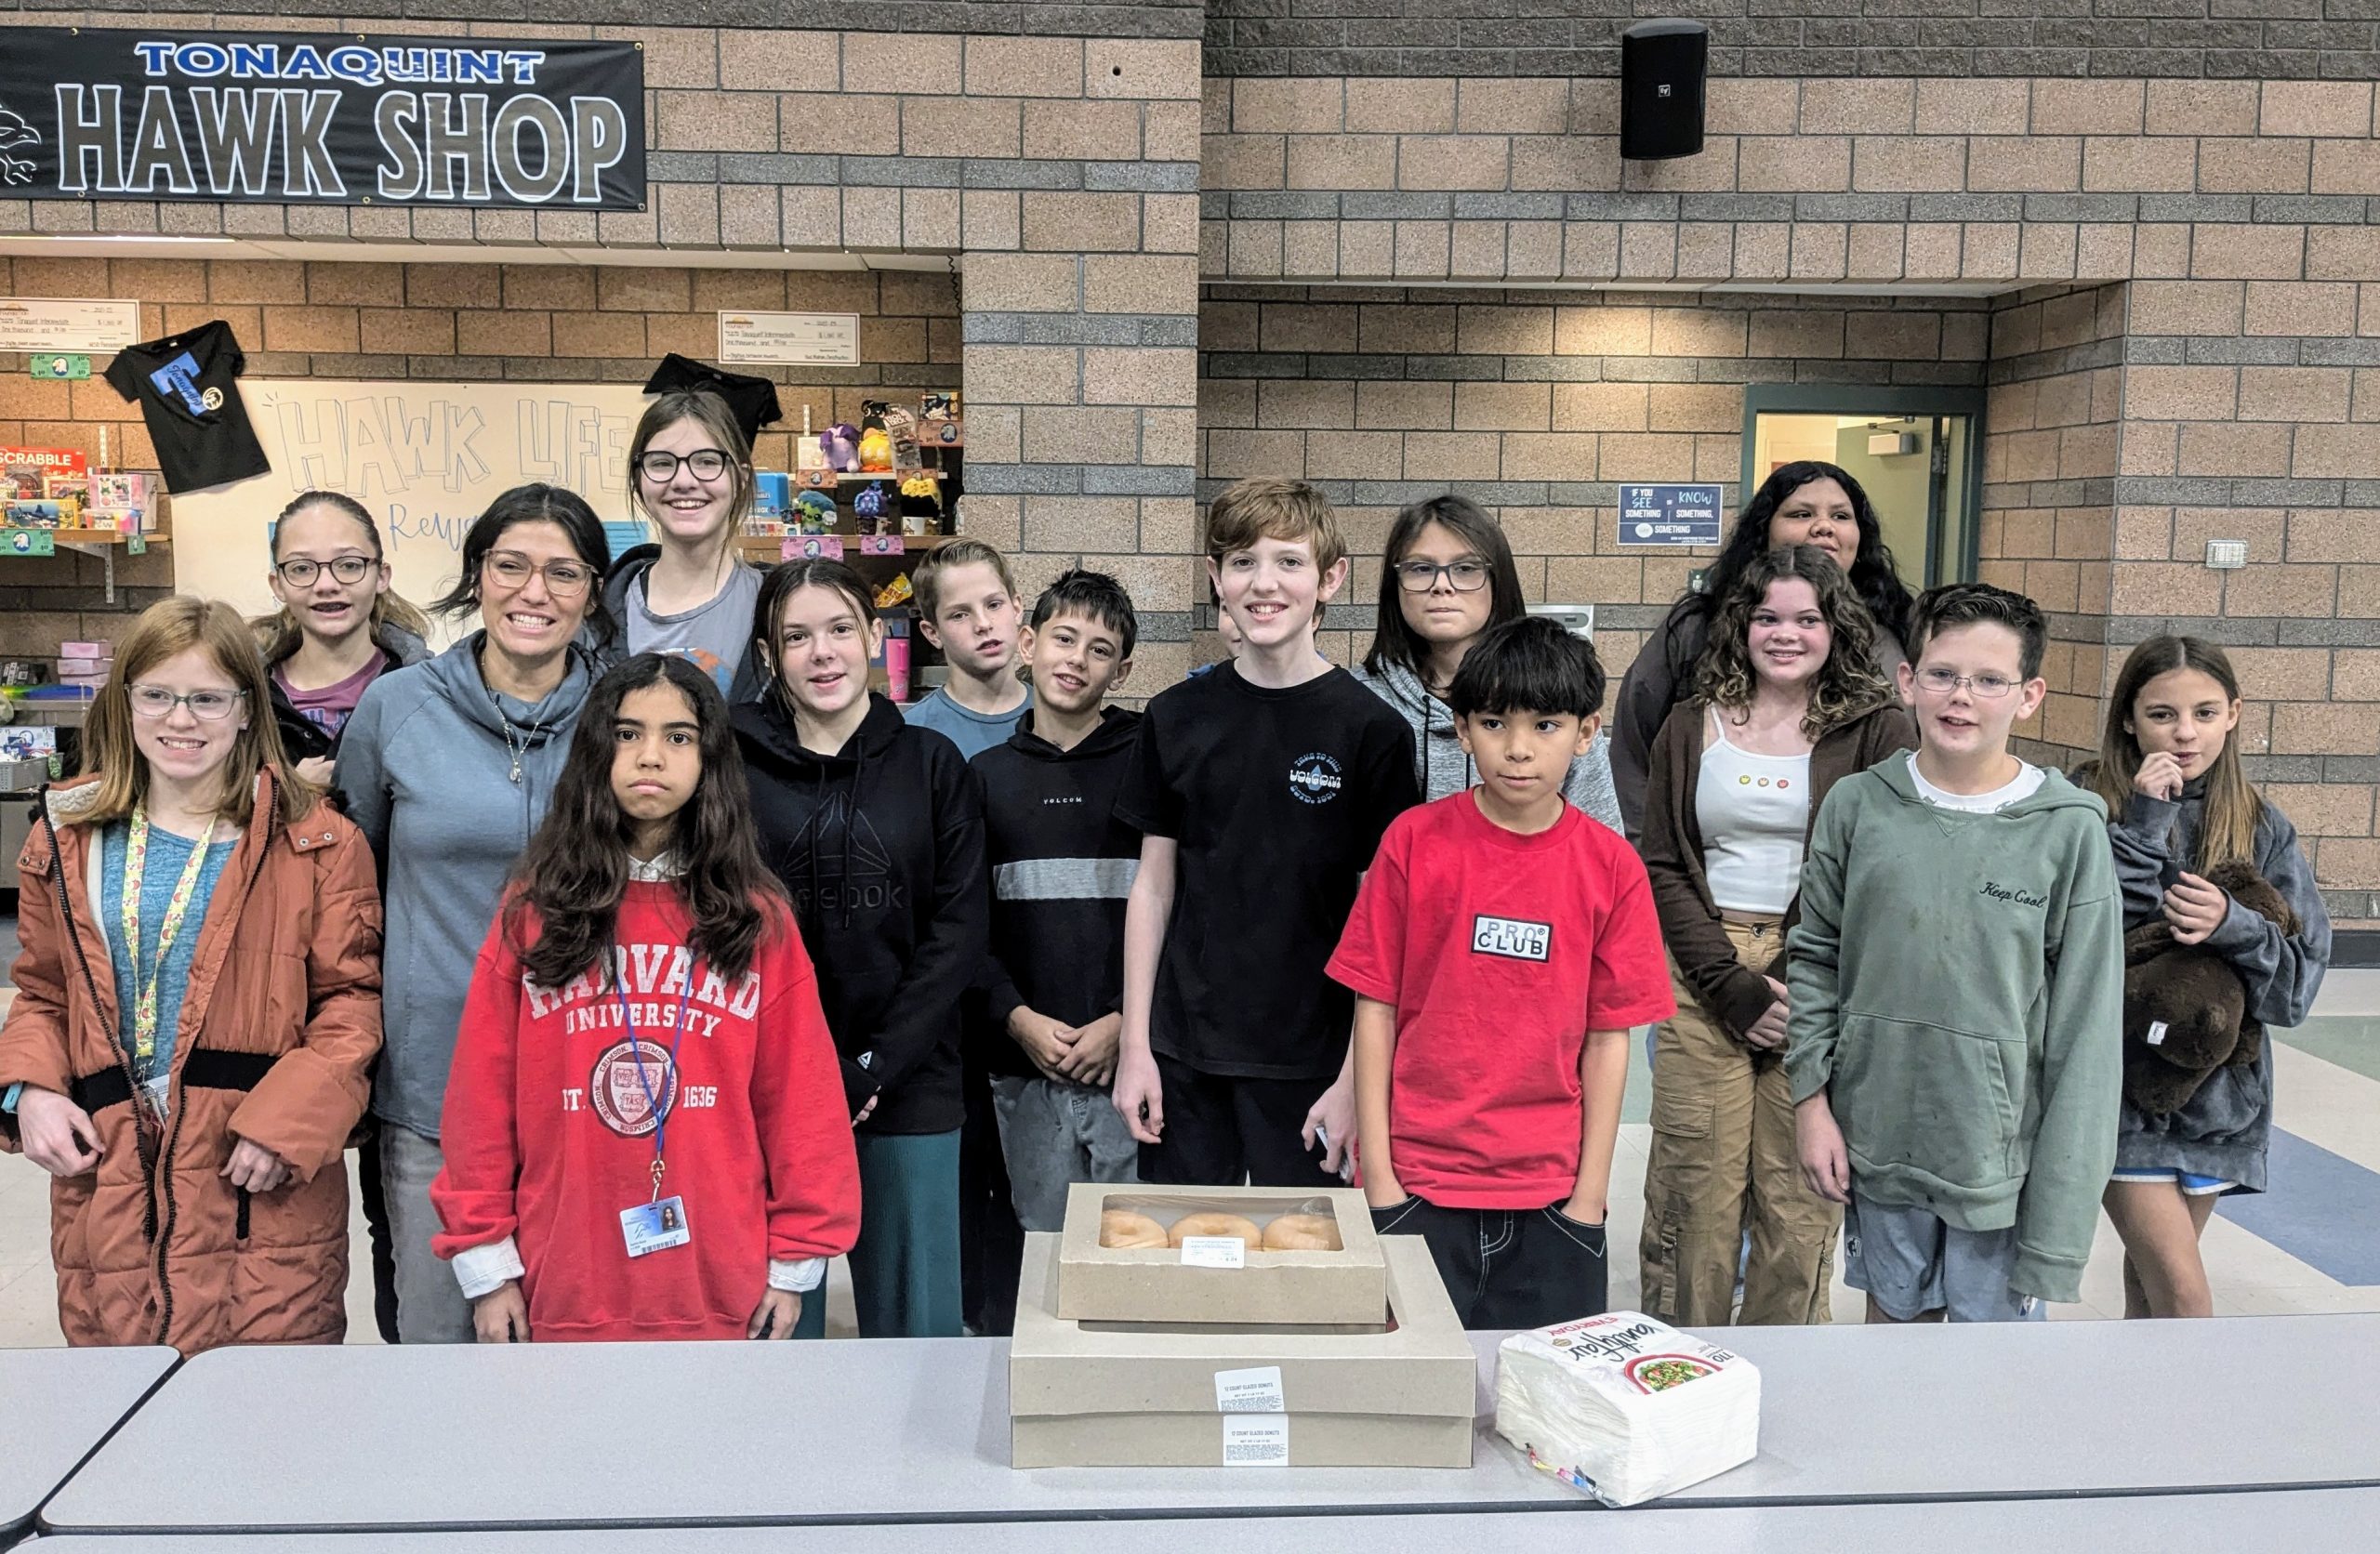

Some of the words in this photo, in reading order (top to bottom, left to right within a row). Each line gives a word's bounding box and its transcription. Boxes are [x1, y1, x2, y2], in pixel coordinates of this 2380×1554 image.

[135, 41, 546, 86] TONAQUINT
[55, 83, 347, 197] HAWK
[374, 90, 627, 203] SHOP
[276, 396, 490, 498] HAWK
[518, 399, 634, 497] LIFE
[1632, 497, 1652, 508] SEE
[1678, 491, 1712, 505] KNOW
[1625, 509, 1661, 518] SOMETHING
[1655, 525, 1690, 533] SOMETHING
[1289, 770, 1342, 789] VOLCOM
[1979, 881, 2013, 902] Keep
[2015, 889, 2048, 908] Cool
[1477, 932, 1543, 955] CLUB
[683, 1086, 718, 1109] 1636
[1548, 1316, 1619, 1337] EVERYDAY
[1712, 1350, 1735, 1363] 110
